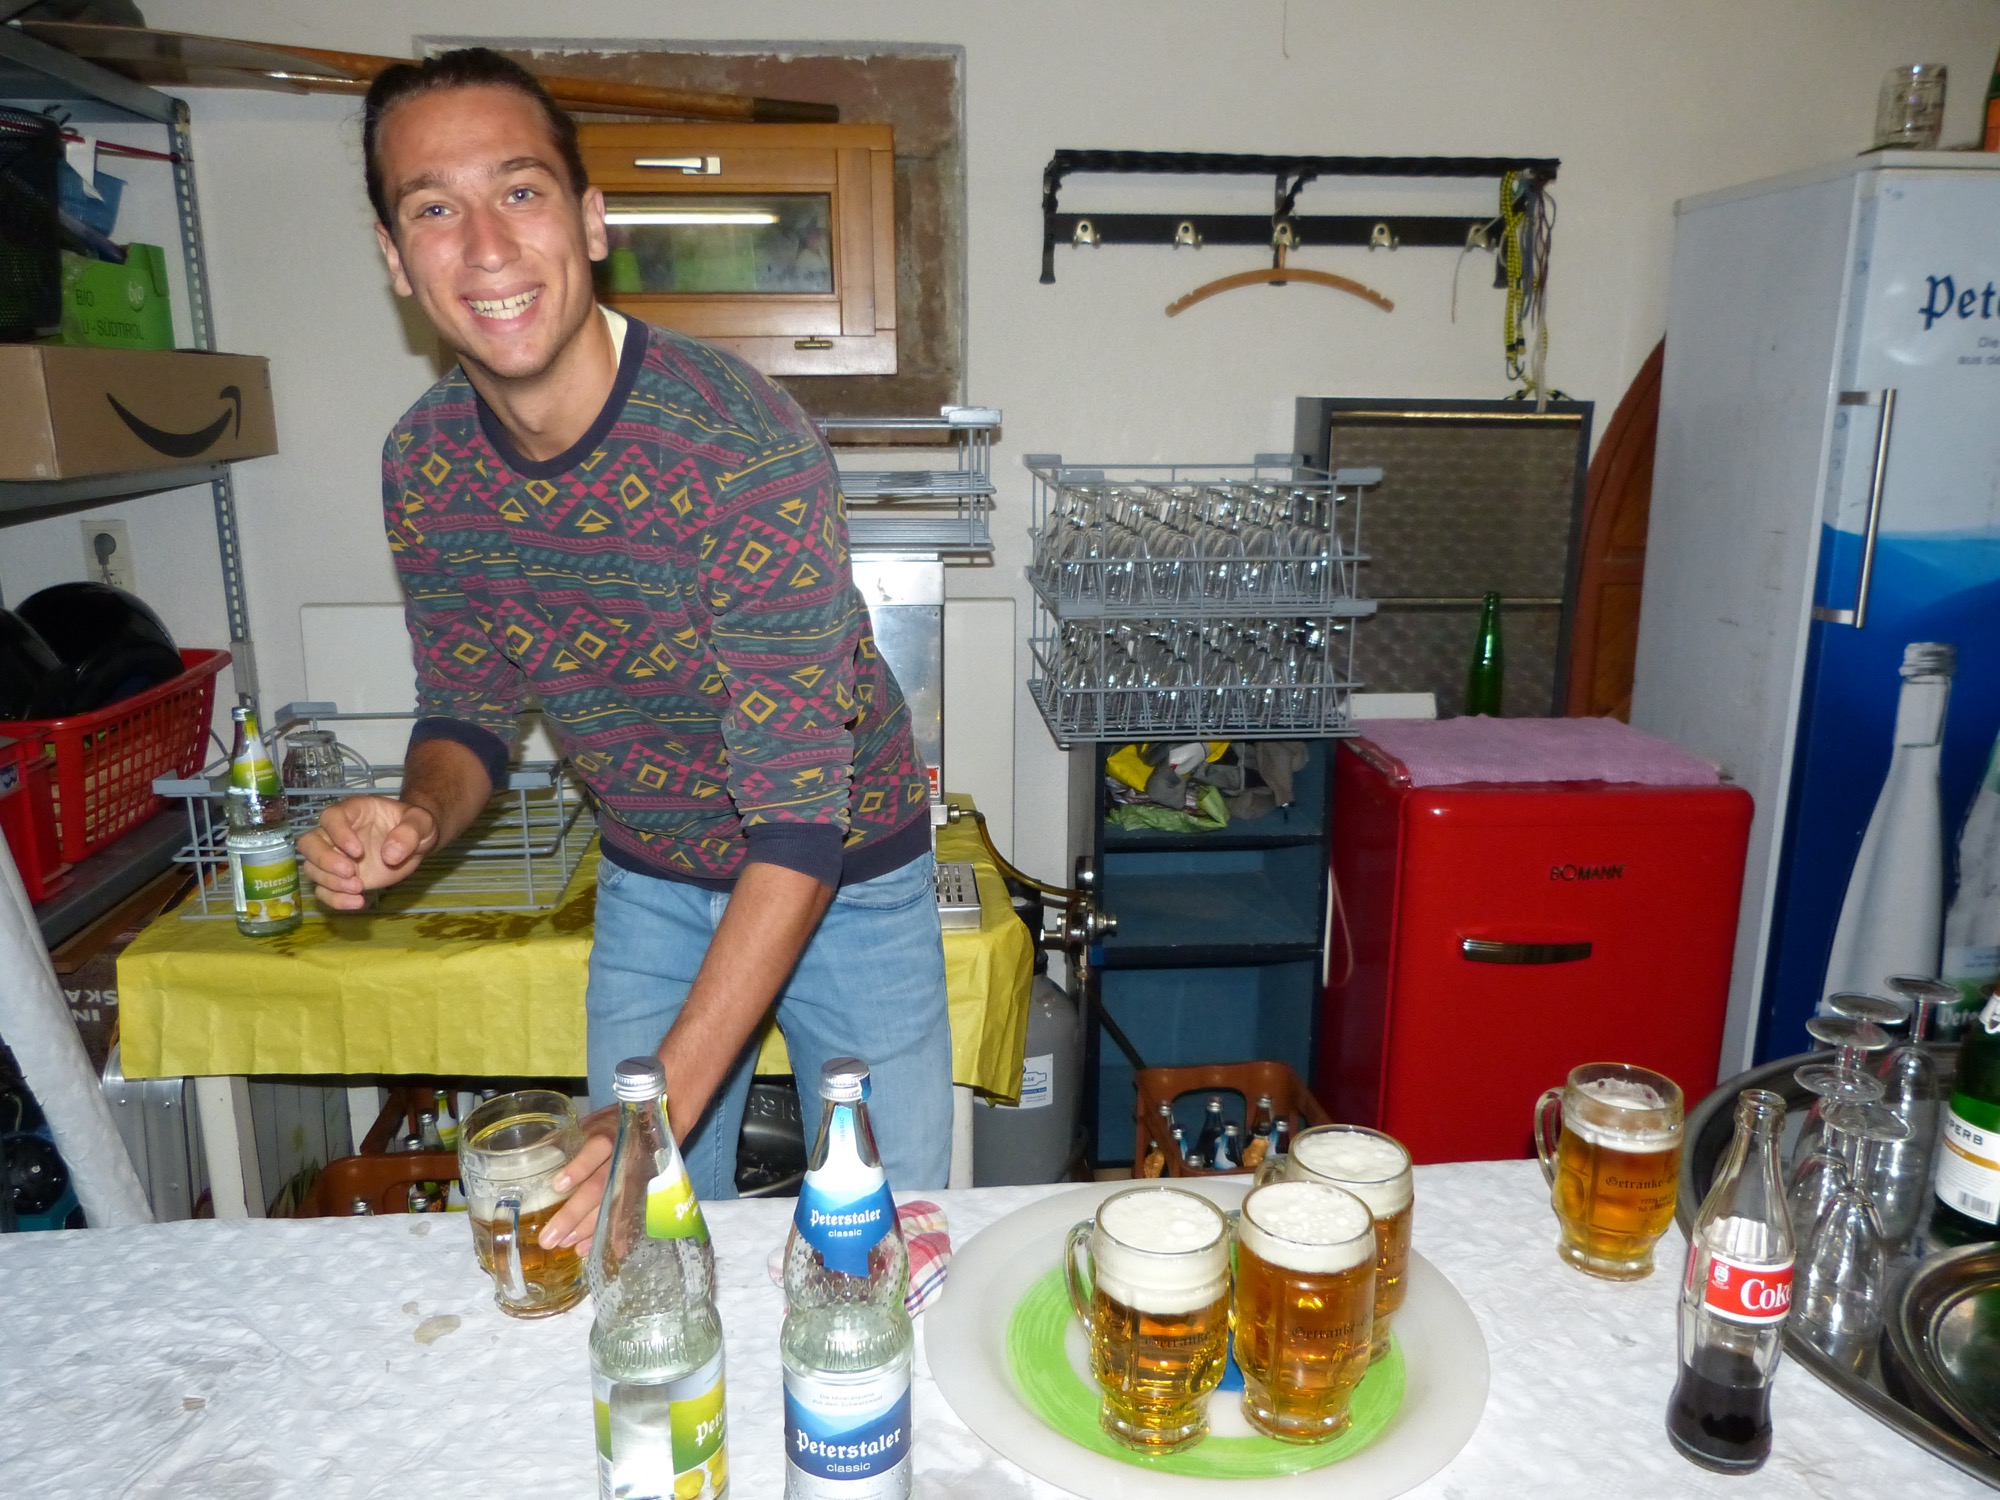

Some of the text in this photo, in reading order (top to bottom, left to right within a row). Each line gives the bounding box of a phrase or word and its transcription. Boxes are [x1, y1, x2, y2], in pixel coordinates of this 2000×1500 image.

[75, 288, 95, 307] BIO
[1918, 274, 2000, 331] Pet
[1550, 864, 1624, 881] BOMANN
[63, 988, 119, 1006] SKA
[810, 1208, 881, 1227] Peterstaler
[828, 1228, 863, 1238] classic
[796, 1427, 901, 1459] Peterstaler
[826, 1461, 871, 1473] classic
